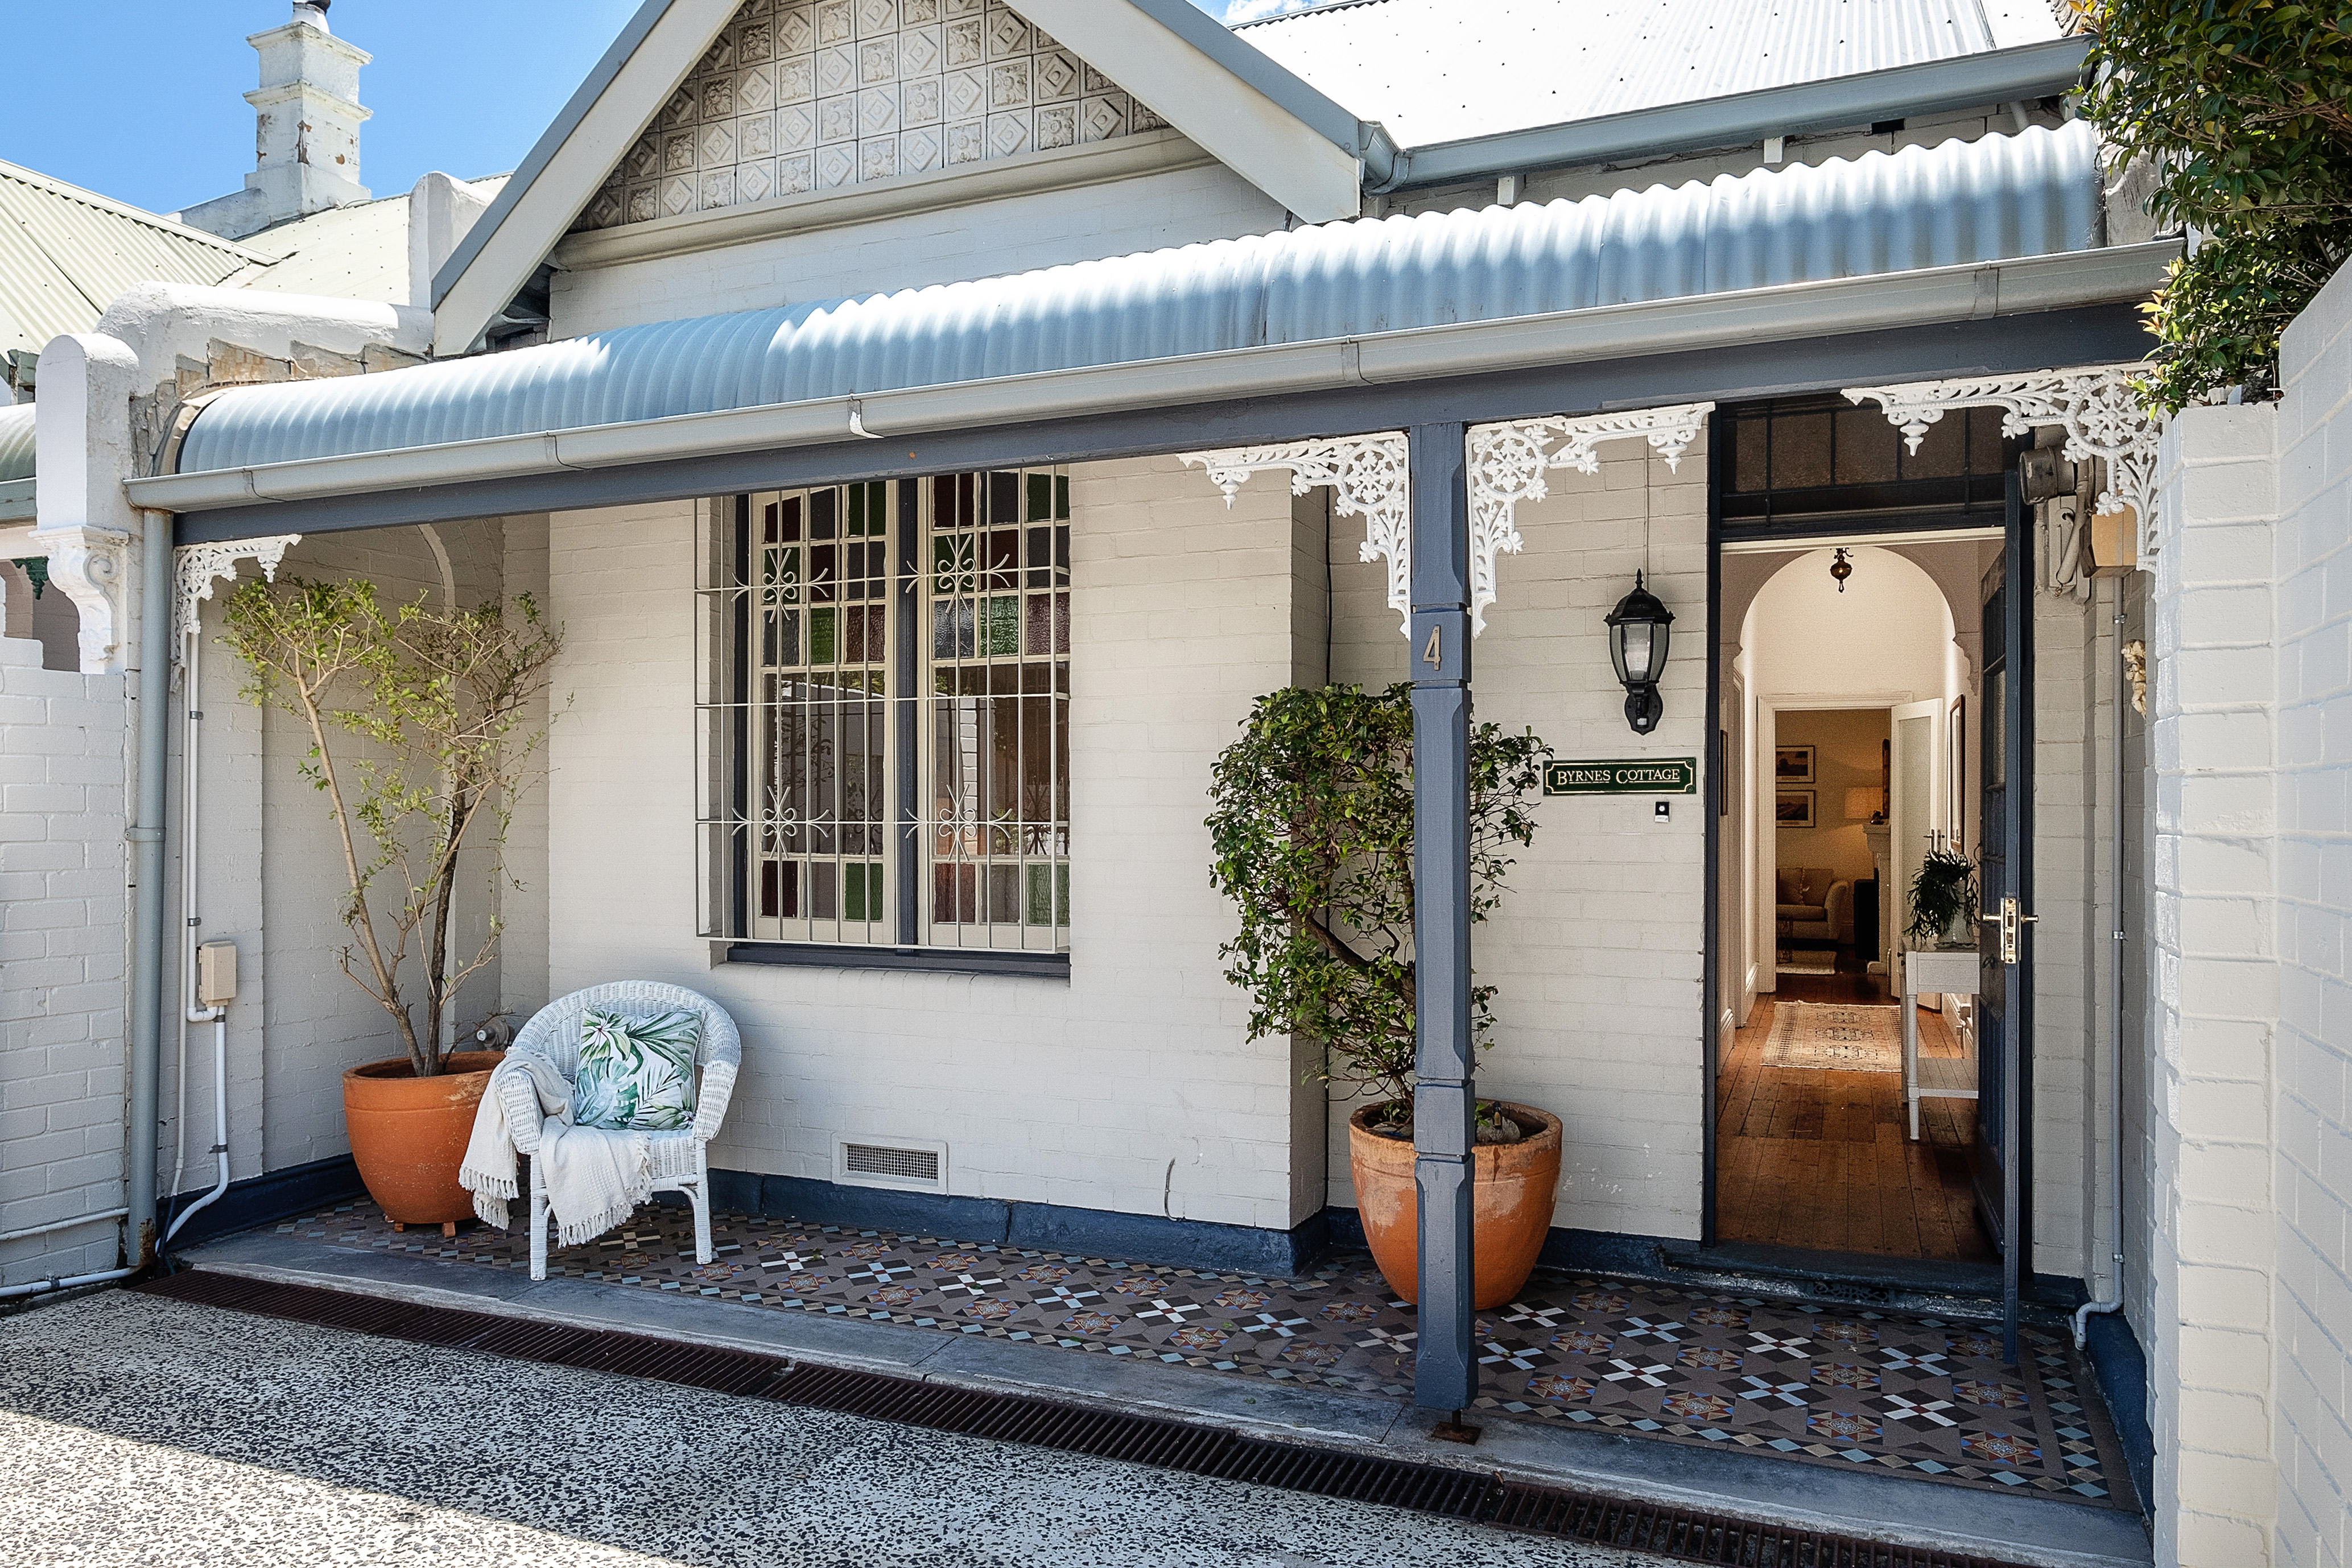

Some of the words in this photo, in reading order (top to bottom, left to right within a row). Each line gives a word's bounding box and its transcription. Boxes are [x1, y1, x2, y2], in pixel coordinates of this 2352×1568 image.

[1423, 625, 1441, 670] 4
[1557, 770, 1611, 785] BYRNES
[1616, 769, 1680, 784] COTTAGE
